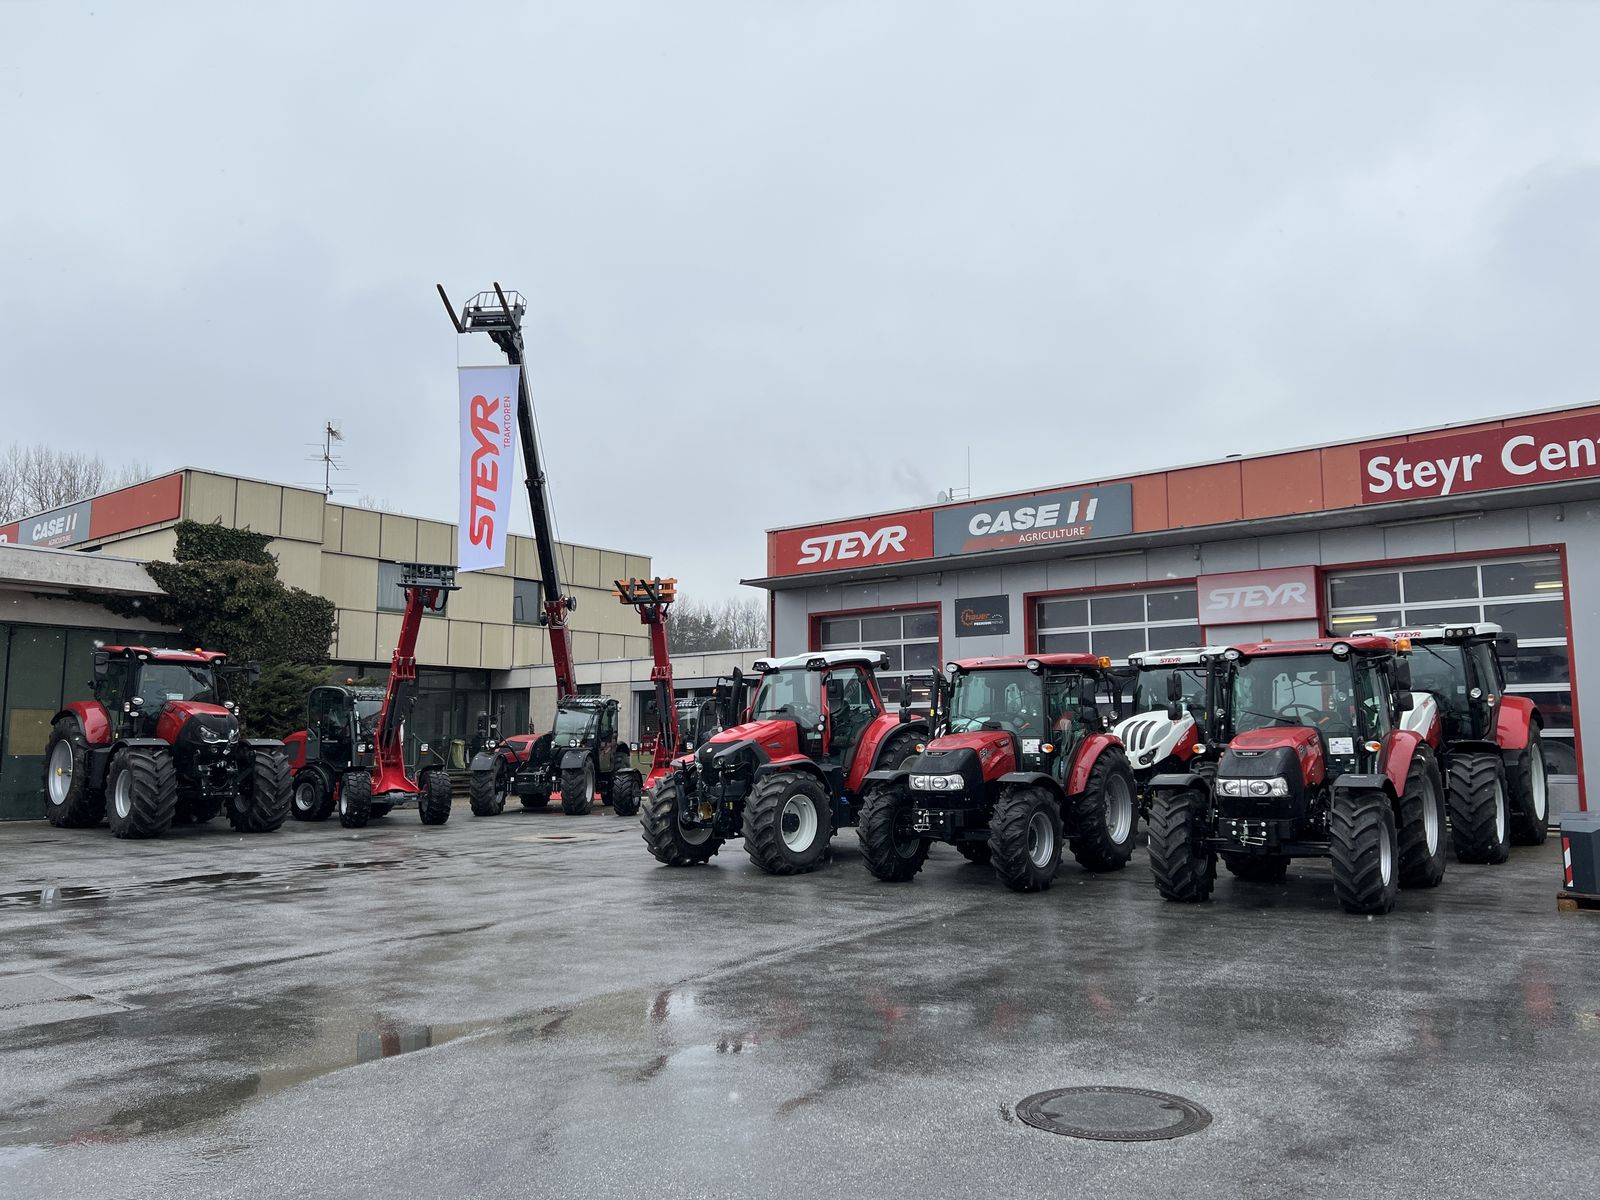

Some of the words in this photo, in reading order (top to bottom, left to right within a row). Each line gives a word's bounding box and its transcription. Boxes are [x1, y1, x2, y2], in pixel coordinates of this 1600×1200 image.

[503, 396, 511, 448] TRAKTOREN
[469, 395, 500, 550] STEYR
[1367, 453, 1482, 496] Steyr
[1501, 435, 1600, 475] Cen
[32, 516, 66, 541] CASE
[968, 503, 1061, 536] CASE
[1018, 526, 1086, 543] AGRICULTURE
[796, 525, 908, 565] STEYR
[1206, 582, 1307, 610] STEYR
[1394, 631, 1422, 639] STEYR
[1159, 656, 1182, 664] STEYR
